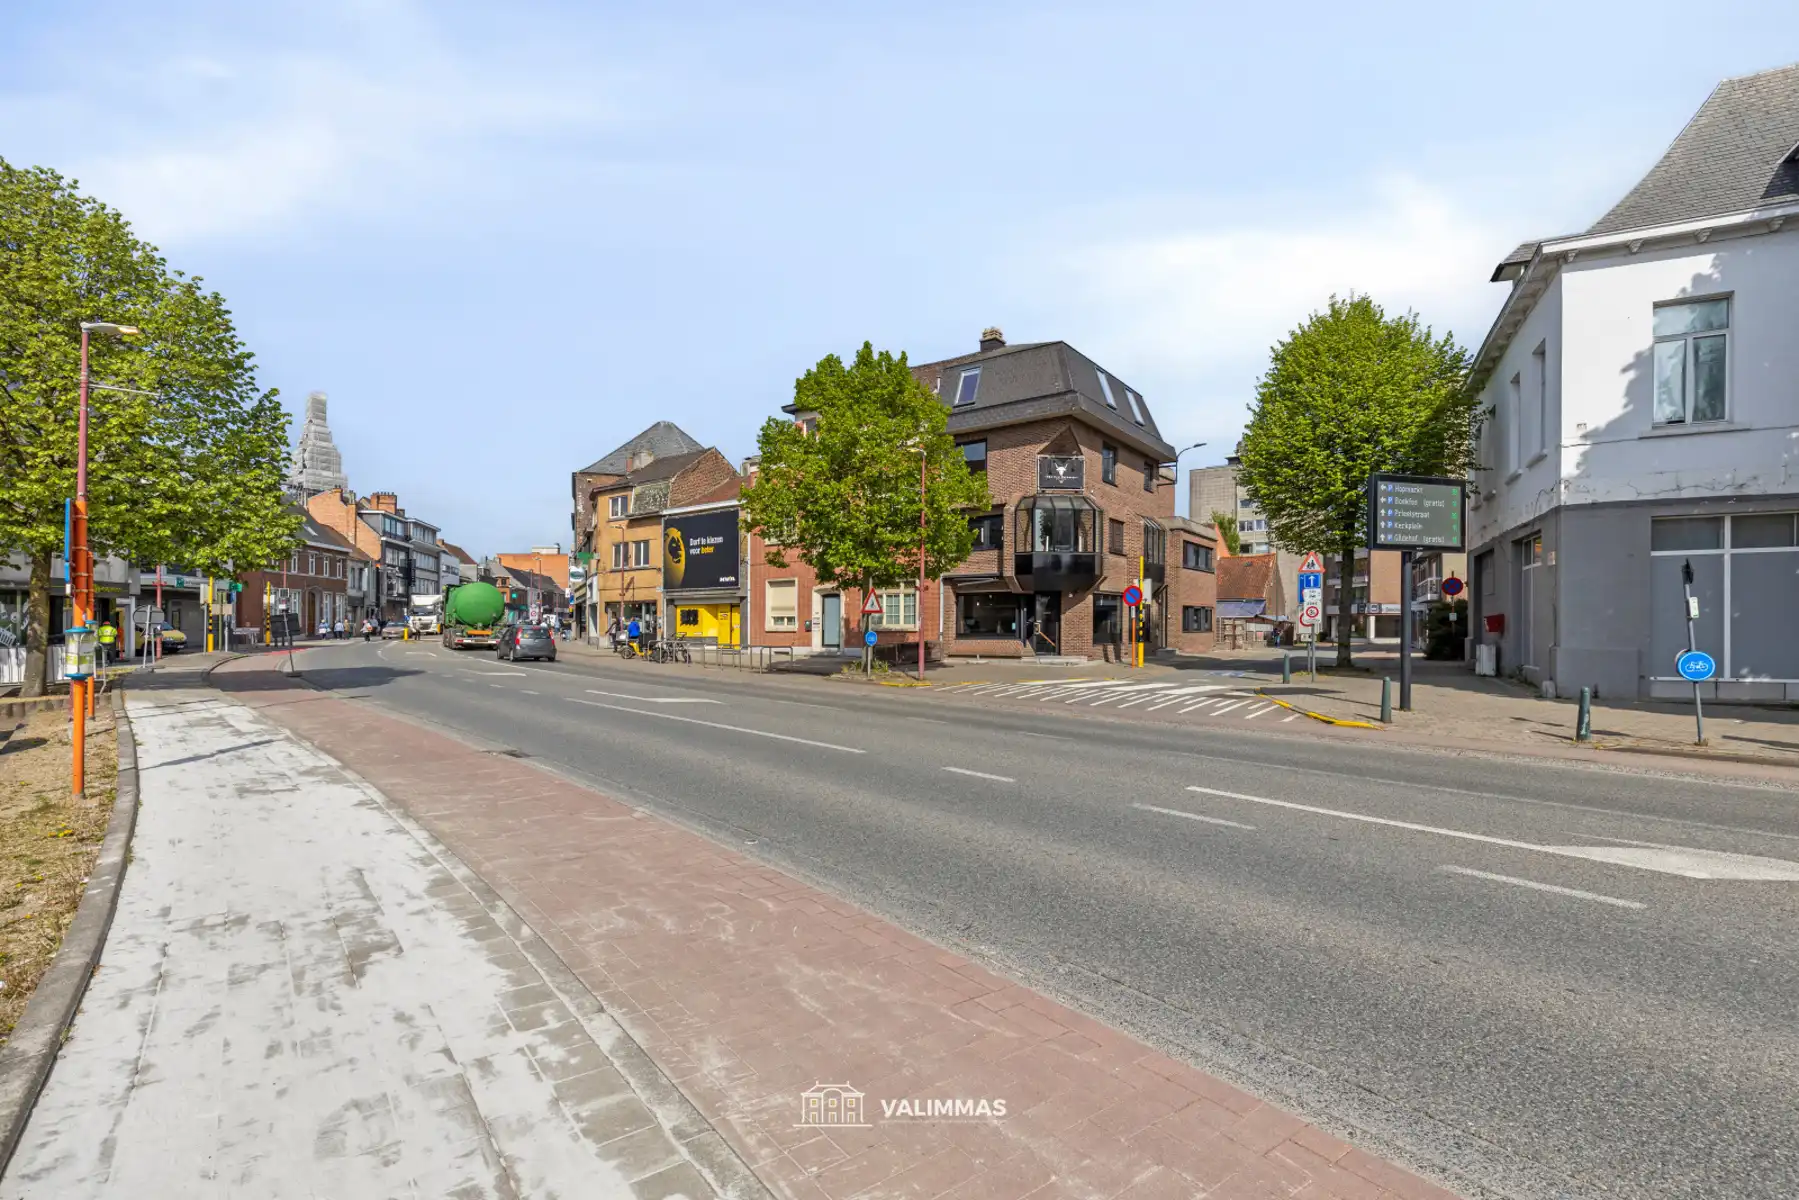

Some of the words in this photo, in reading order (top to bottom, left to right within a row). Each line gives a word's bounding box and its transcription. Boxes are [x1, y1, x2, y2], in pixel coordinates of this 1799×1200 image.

[1394, 484, 1423, 494] Hopmarkt
[1394, 521, 1423, 530] Kerkplein
[707, 536, 723, 544] kiezen
